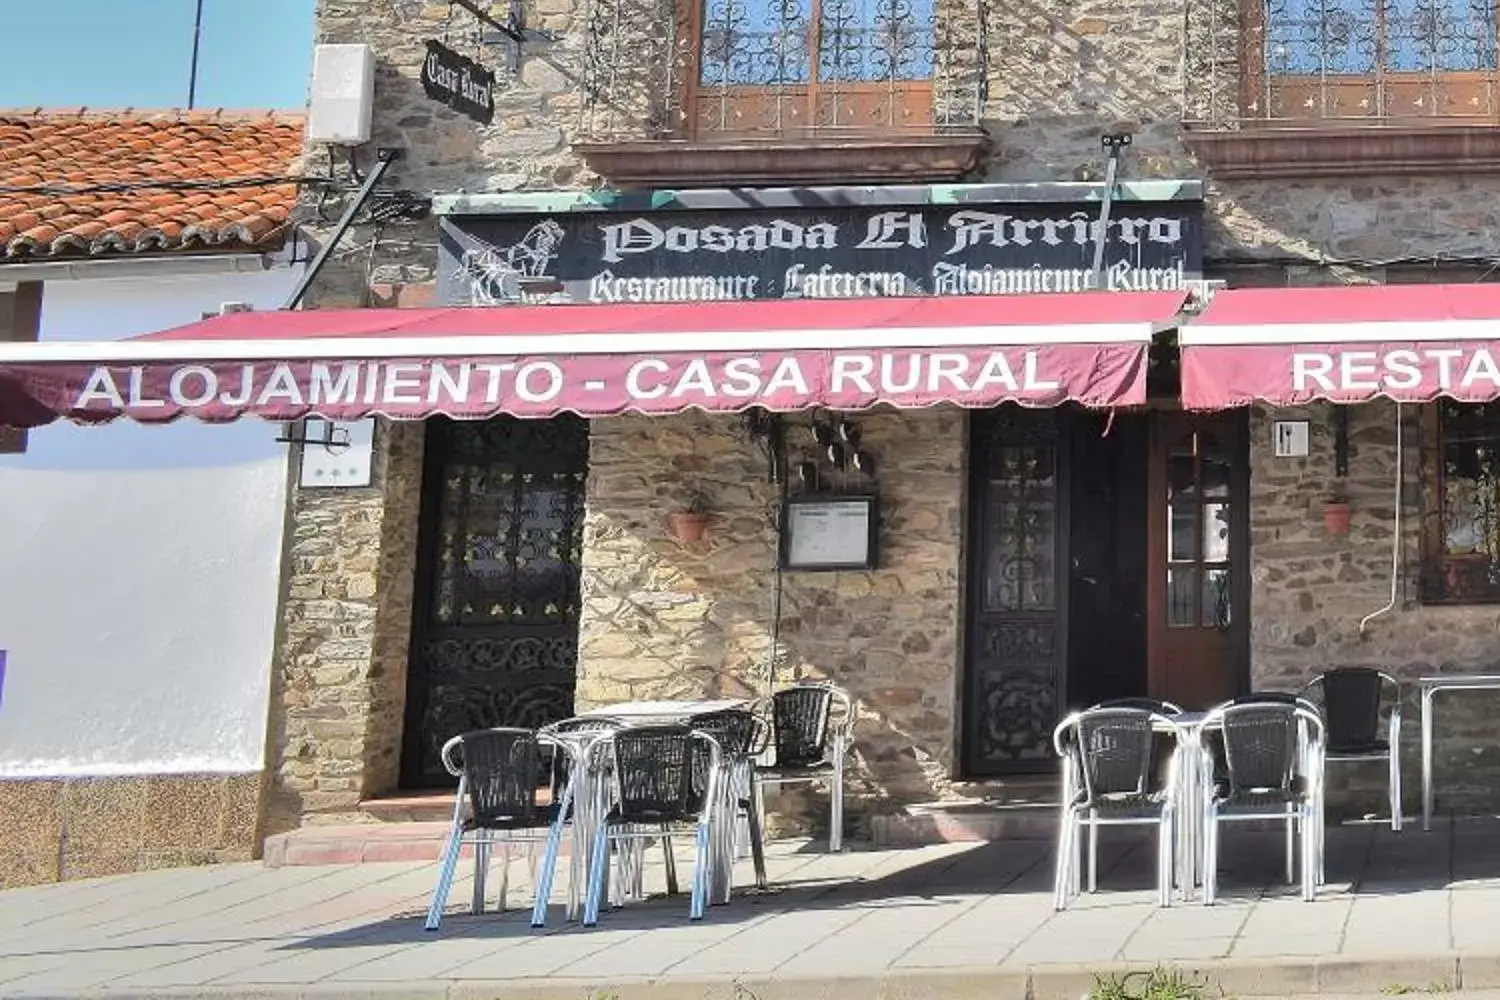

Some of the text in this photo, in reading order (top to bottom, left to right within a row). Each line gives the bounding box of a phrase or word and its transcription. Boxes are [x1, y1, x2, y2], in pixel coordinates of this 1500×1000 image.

[427, 51, 459, 93] Casa
[598, 210, 1182, 263] Posada El Arriero
[589, 268, 760, 303] Restaurante
[782, 263, 906, 299] Cafeteria
[1107, 259, 1184, 292] Rural
[74, 351, 1060, 408] ALOJAMIENTO - CASA RURAL
